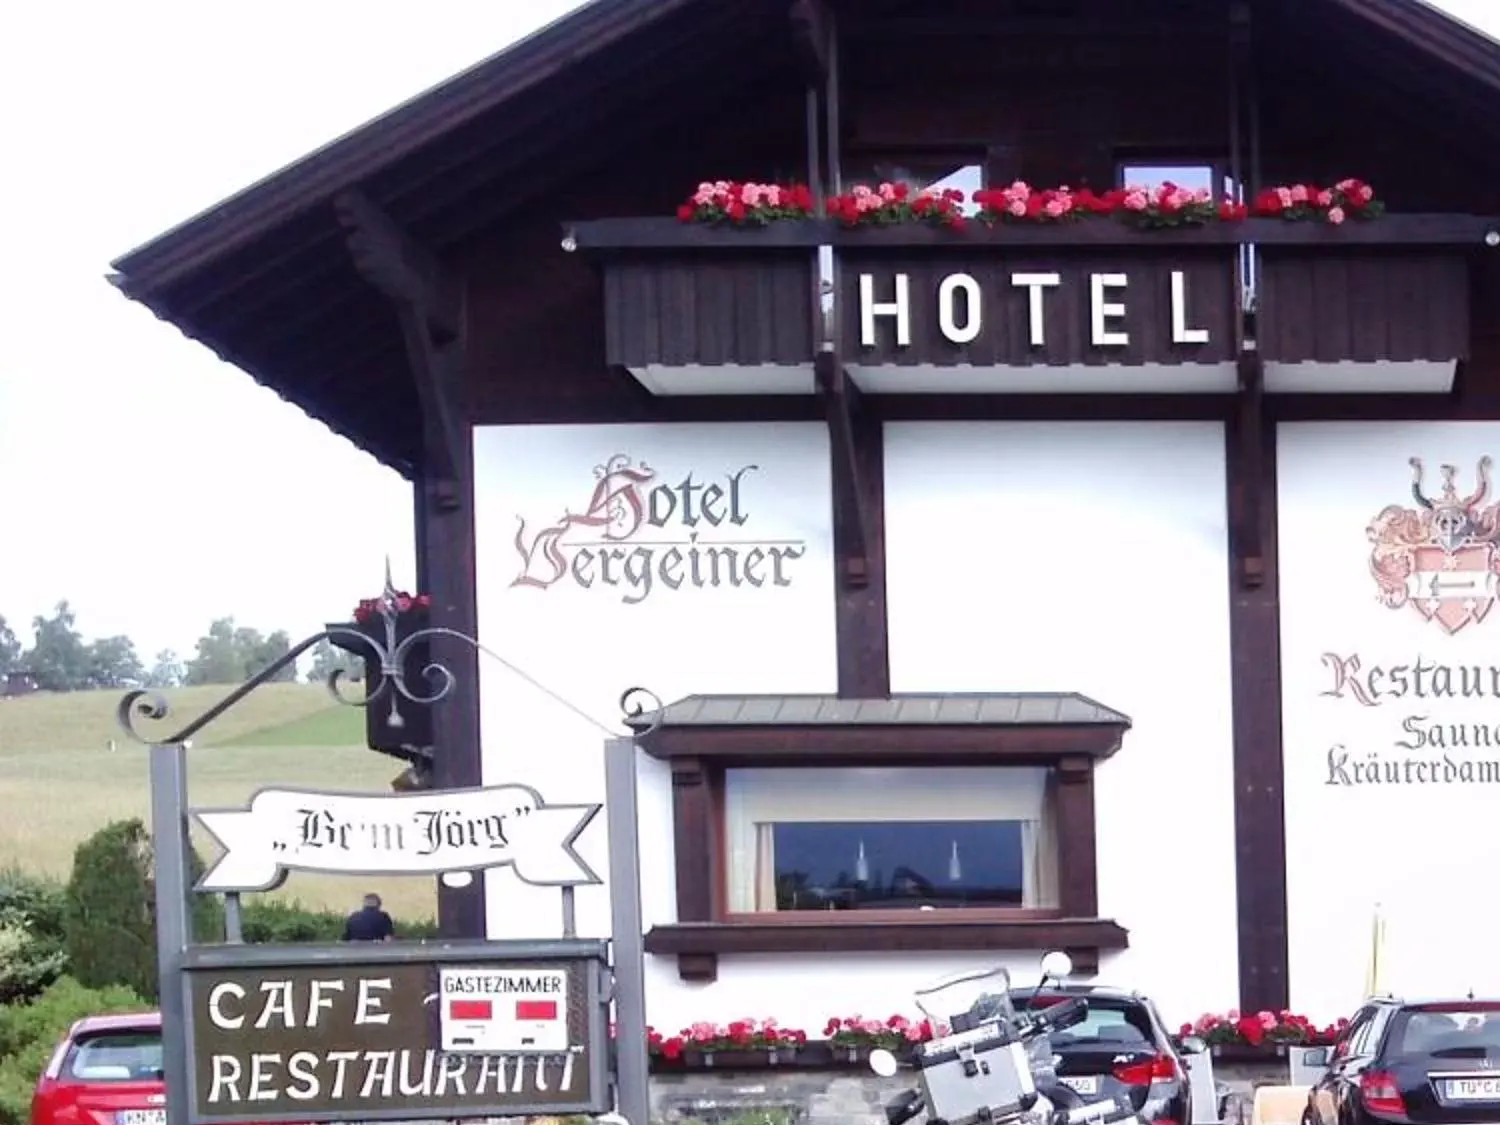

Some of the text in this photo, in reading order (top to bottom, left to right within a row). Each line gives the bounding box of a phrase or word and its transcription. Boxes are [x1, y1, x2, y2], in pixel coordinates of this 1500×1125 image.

[859, 271, 1210, 346] HOTEL
[557, 453, 759, 541] Hotel
[508, 514, 807, 605] Vergeiner
[209, 978, 392, 1029] CAFE
[208, 1045, 585, 1102] RESTAURANT
